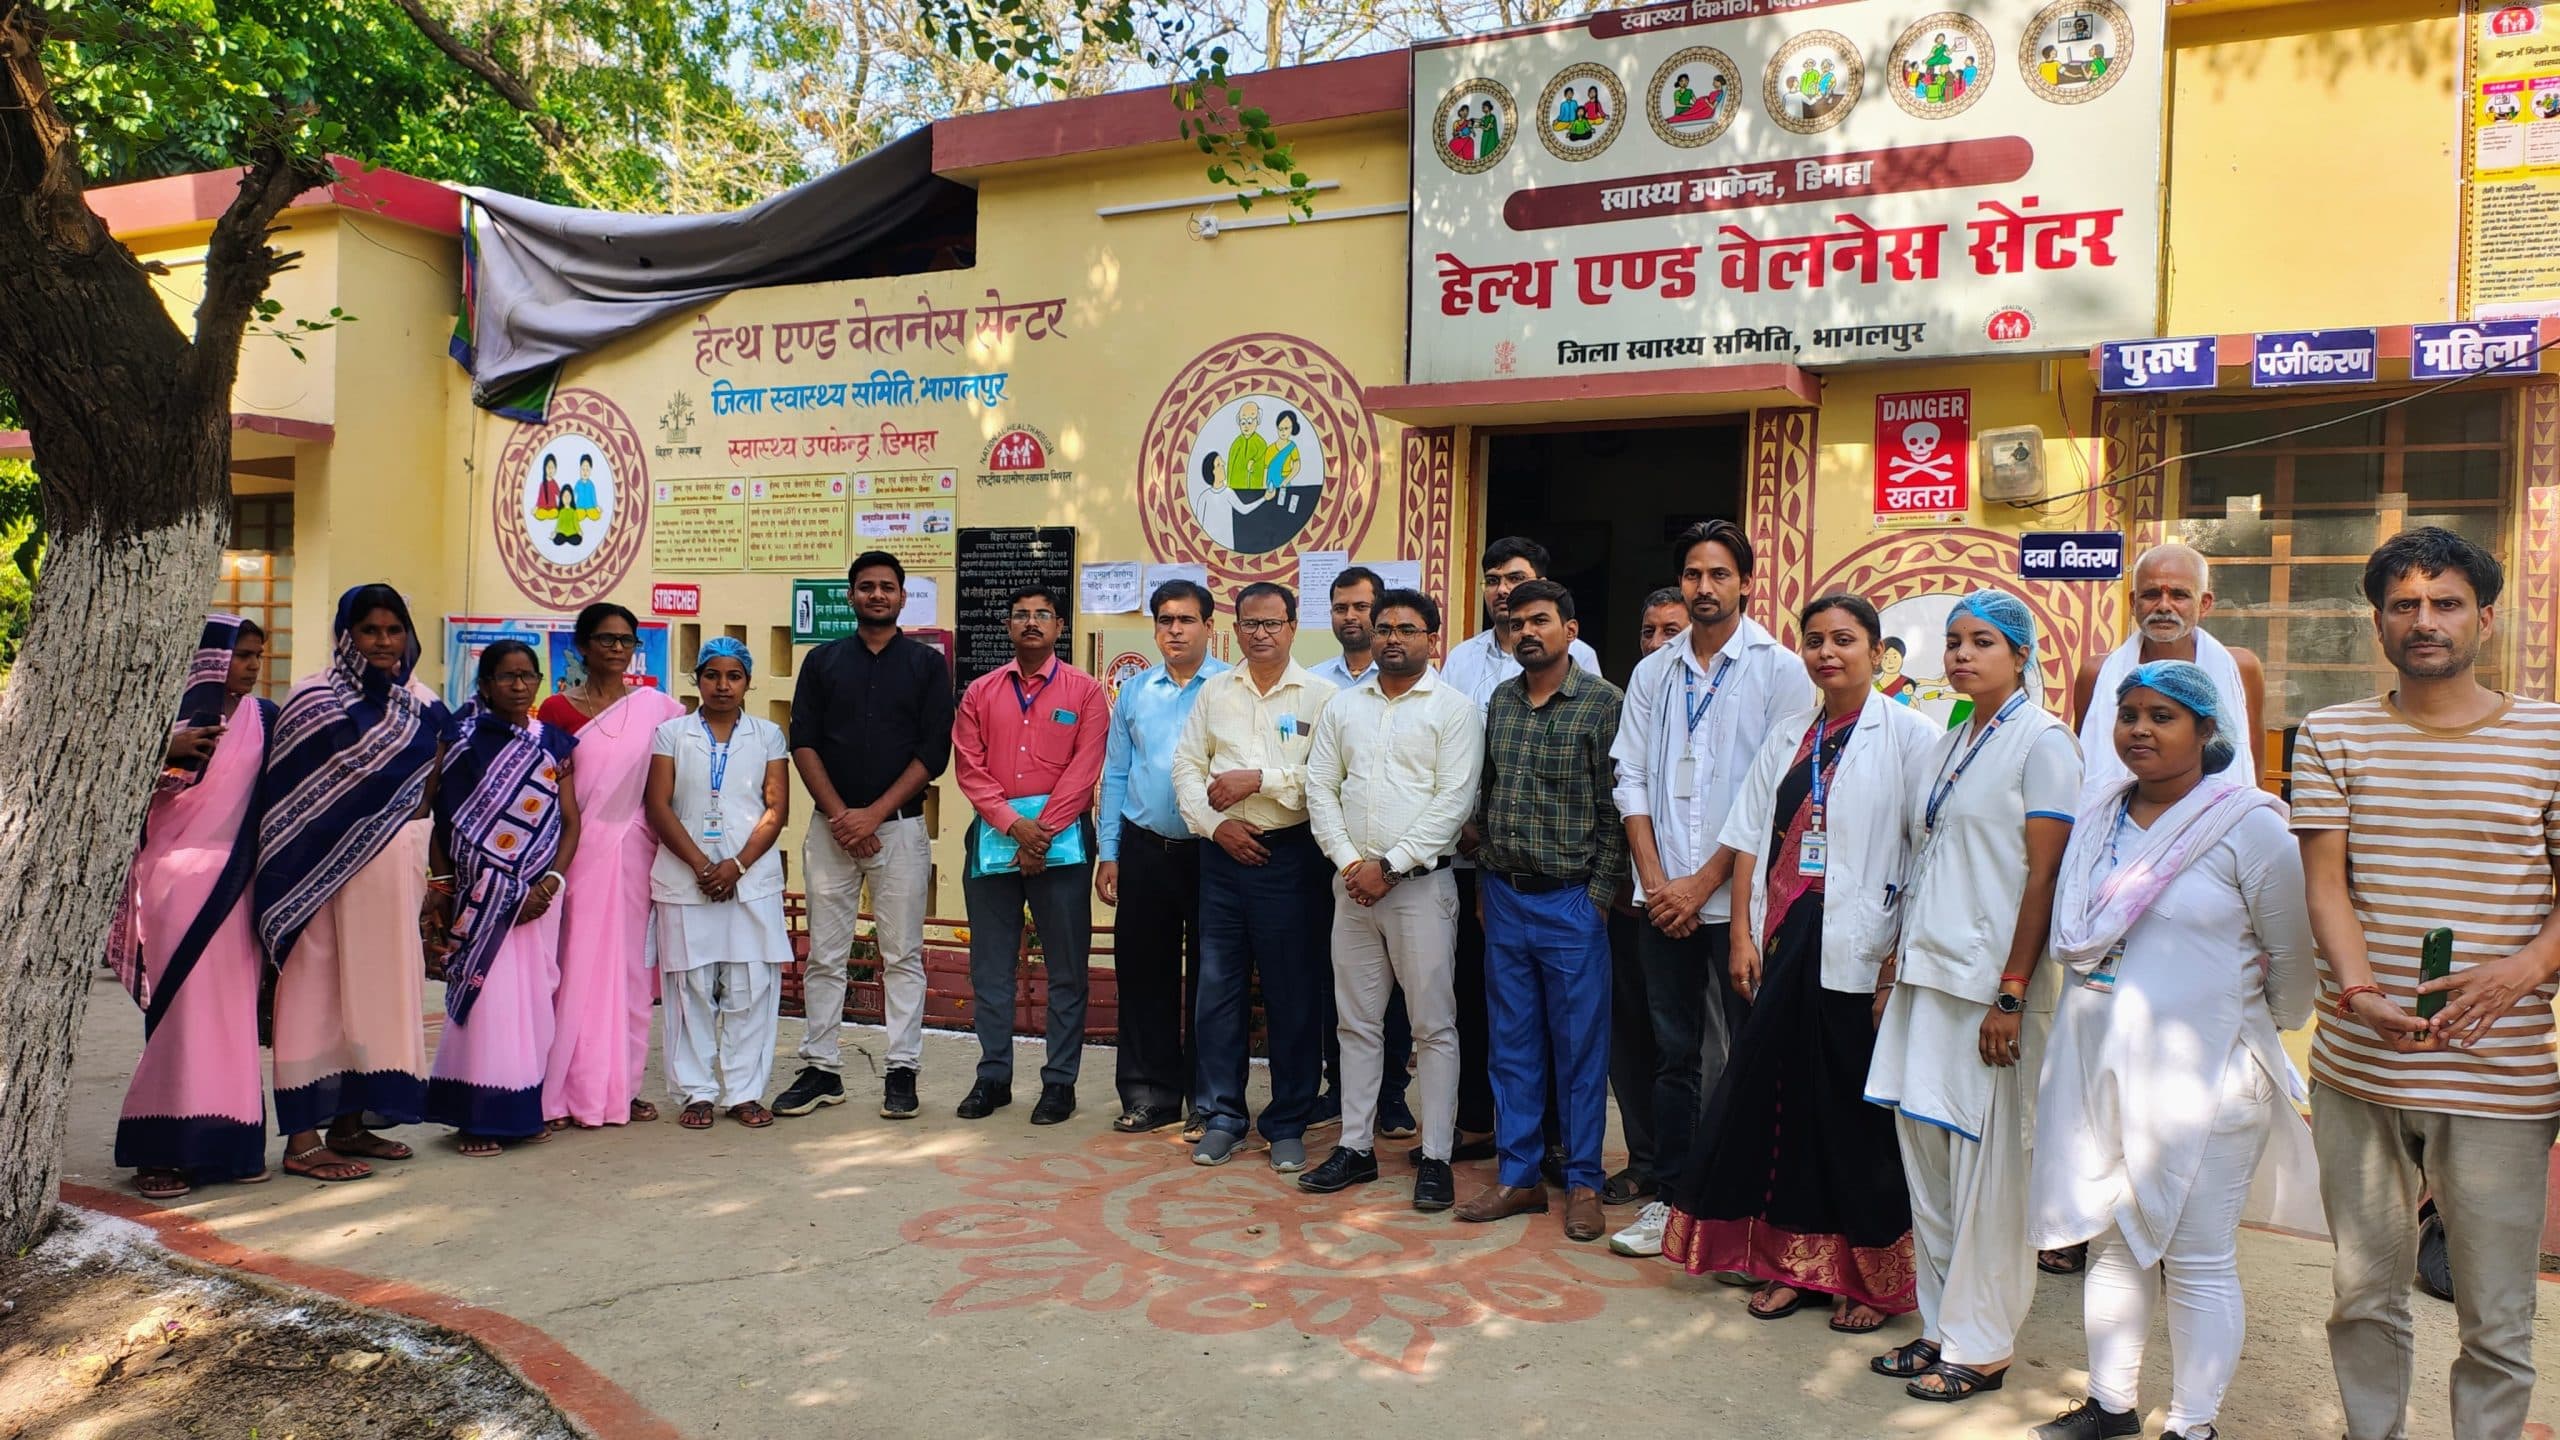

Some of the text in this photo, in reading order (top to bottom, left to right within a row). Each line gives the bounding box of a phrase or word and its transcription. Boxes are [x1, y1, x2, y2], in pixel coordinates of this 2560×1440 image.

[1621, 5, 1687, 30] स्वास्थ्य
[1600, 160, 1874, 211] स्वास्थ्य उपकेन्द्र, डिमहा
[1435, 196, 2124, 316] हेल्थ एण्ड वेलनेस सेंटर
[692, 288, 1068, 376] हेल्थ एण्ड वेलनेस सेन्टर
[1558, 322, 1926, 365] जिला स्वास्थ्य समिति, भागलपुर
[2420, 329, 2532, 373] महिला
[2257, 340, 2372, 376] पंजीकरण
[711, 379, 767, 416] जिला
[770, 383, 848, 413] स्वास्थ्य
[920, 373, 1008, 408] भागलपुर
[1883, 396, 1964, 421] DANGER
[728, 438, 798, 467] स्वास्थ्य
[980, 423, 1055, 465] NATIONAL HEALTH MISSION
[1885, 485, 1957, 509] खतरा
[2023, 541, 2118, 569] दवा वितरण
[654, 588, 698, 611] STRETCHER
